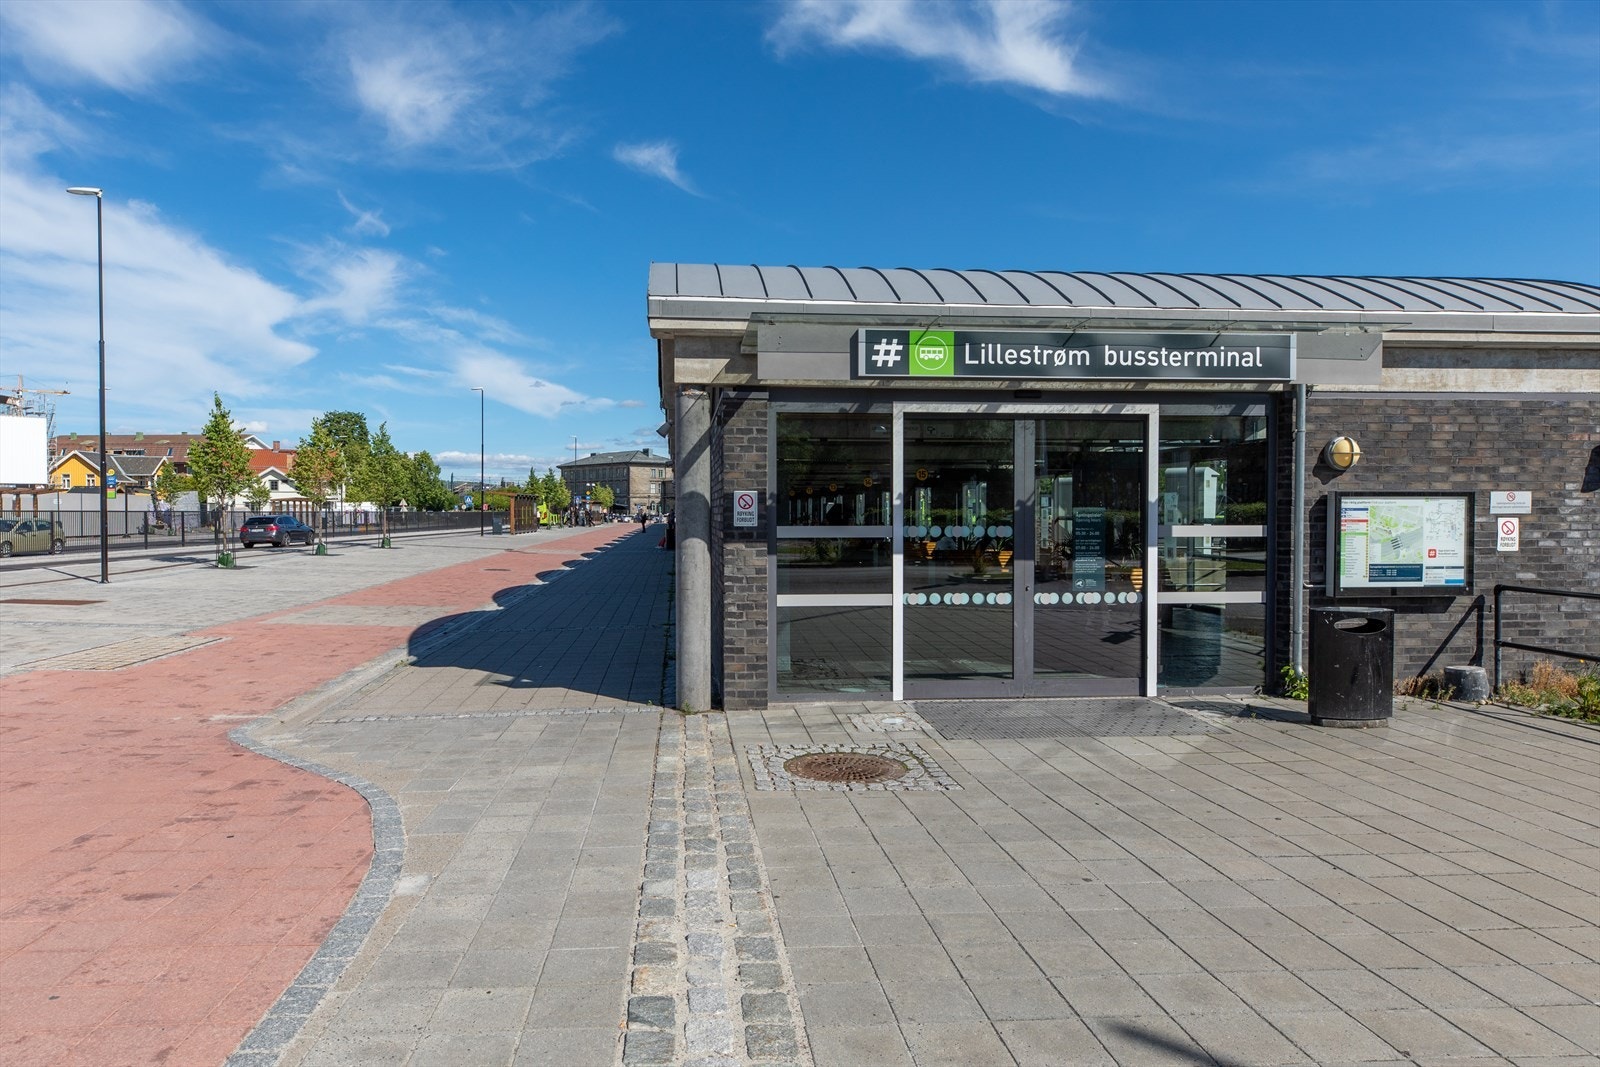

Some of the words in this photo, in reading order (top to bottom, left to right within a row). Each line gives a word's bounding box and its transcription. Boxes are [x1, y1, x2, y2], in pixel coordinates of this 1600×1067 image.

[965, 343, 1090, 367] Lillestrøm
[1104, 345, 1263, 367] bussterminal
[918, 470, 927, 479] 15
